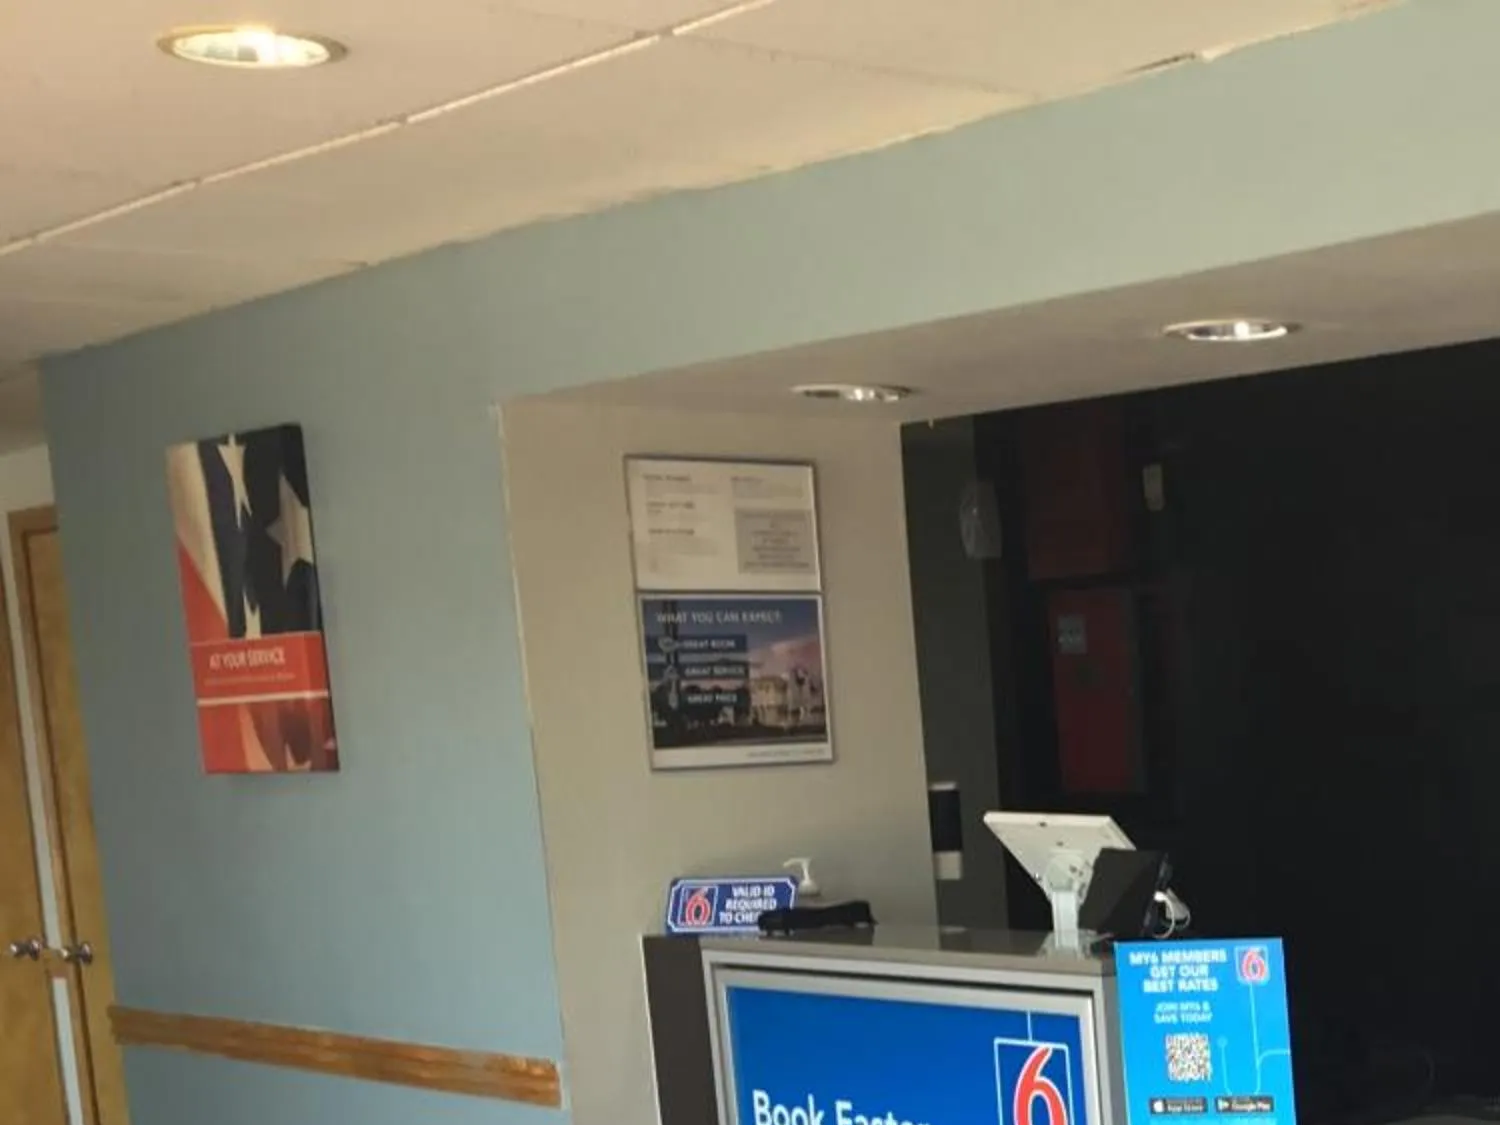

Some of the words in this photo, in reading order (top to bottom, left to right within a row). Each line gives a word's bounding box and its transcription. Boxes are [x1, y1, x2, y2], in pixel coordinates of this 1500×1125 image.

[691, 609, 714, 624] YOU
[716, 609, 739, 624] CAN
[732, 885, 761, 897] VALID
[763, 884, 775, 897] ID
[685, 886, 711, 926] 6
[725, 897, 777, 911] REQUIRED
[719, 911, 733, 924] TO
[735, 911, 760, 924] CHE
[1161, 948, 1227, 964] MEMBERS
[1150, 964, 1176, 978] GET
[1179, 963, 1209, 978] OUR
[1143, 979, 1173, 993] BEST
[1177, 977, 1218, 992] RATES
